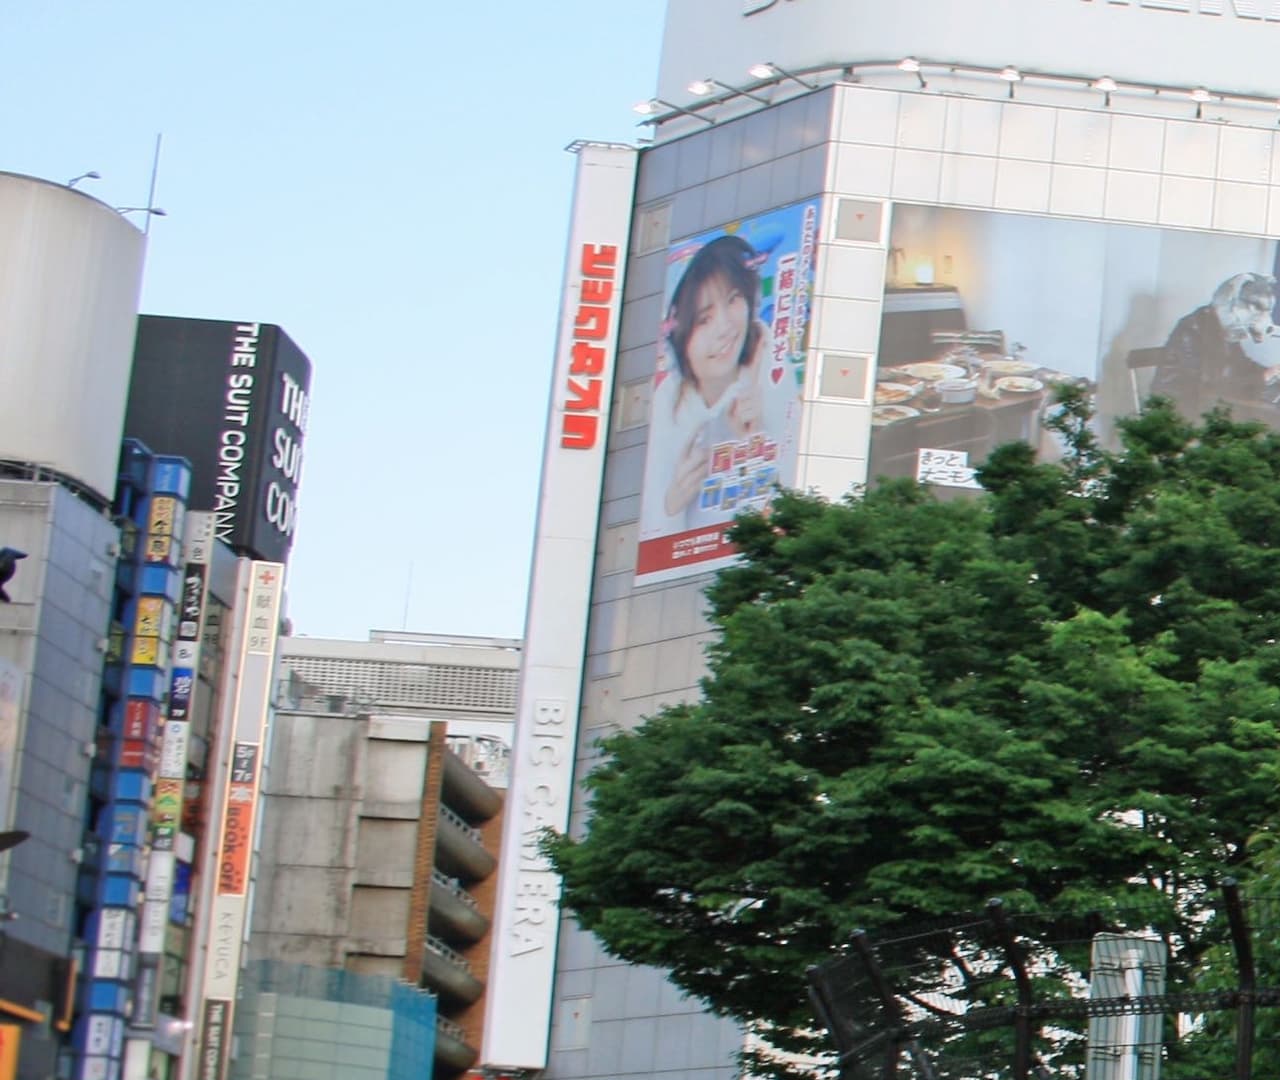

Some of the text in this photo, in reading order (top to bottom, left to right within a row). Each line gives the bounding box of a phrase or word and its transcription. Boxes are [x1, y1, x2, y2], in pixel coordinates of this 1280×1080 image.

[213, 323, 259, 544] THE SUIT COMPANY
